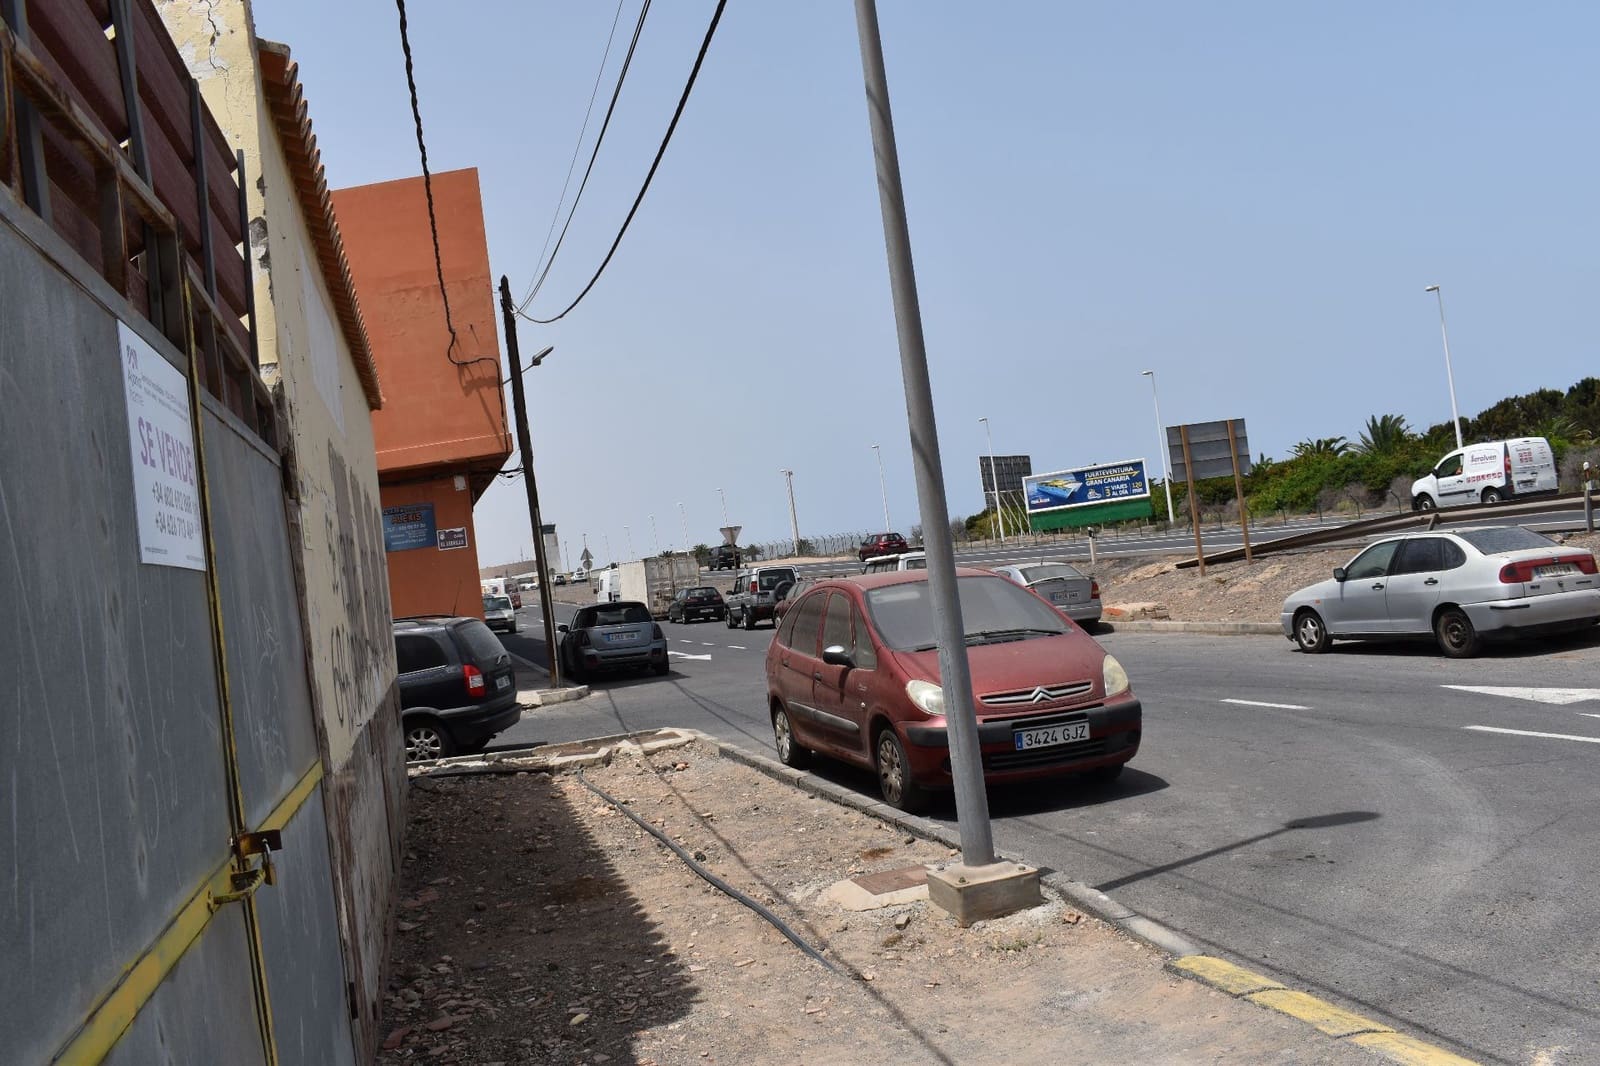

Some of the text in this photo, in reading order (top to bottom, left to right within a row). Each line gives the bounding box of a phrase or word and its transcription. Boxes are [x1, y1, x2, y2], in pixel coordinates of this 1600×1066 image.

[138, 415, 194, 486] SE VENDE
[1085, 465, 1134, 479] FUERTEVENTURA
[1086, 475, 1131, 487] GRAN CANARIA
[1105, 488, 1112, 497] 3
[1025, 725, 1087, 747] 3424 GJZ
